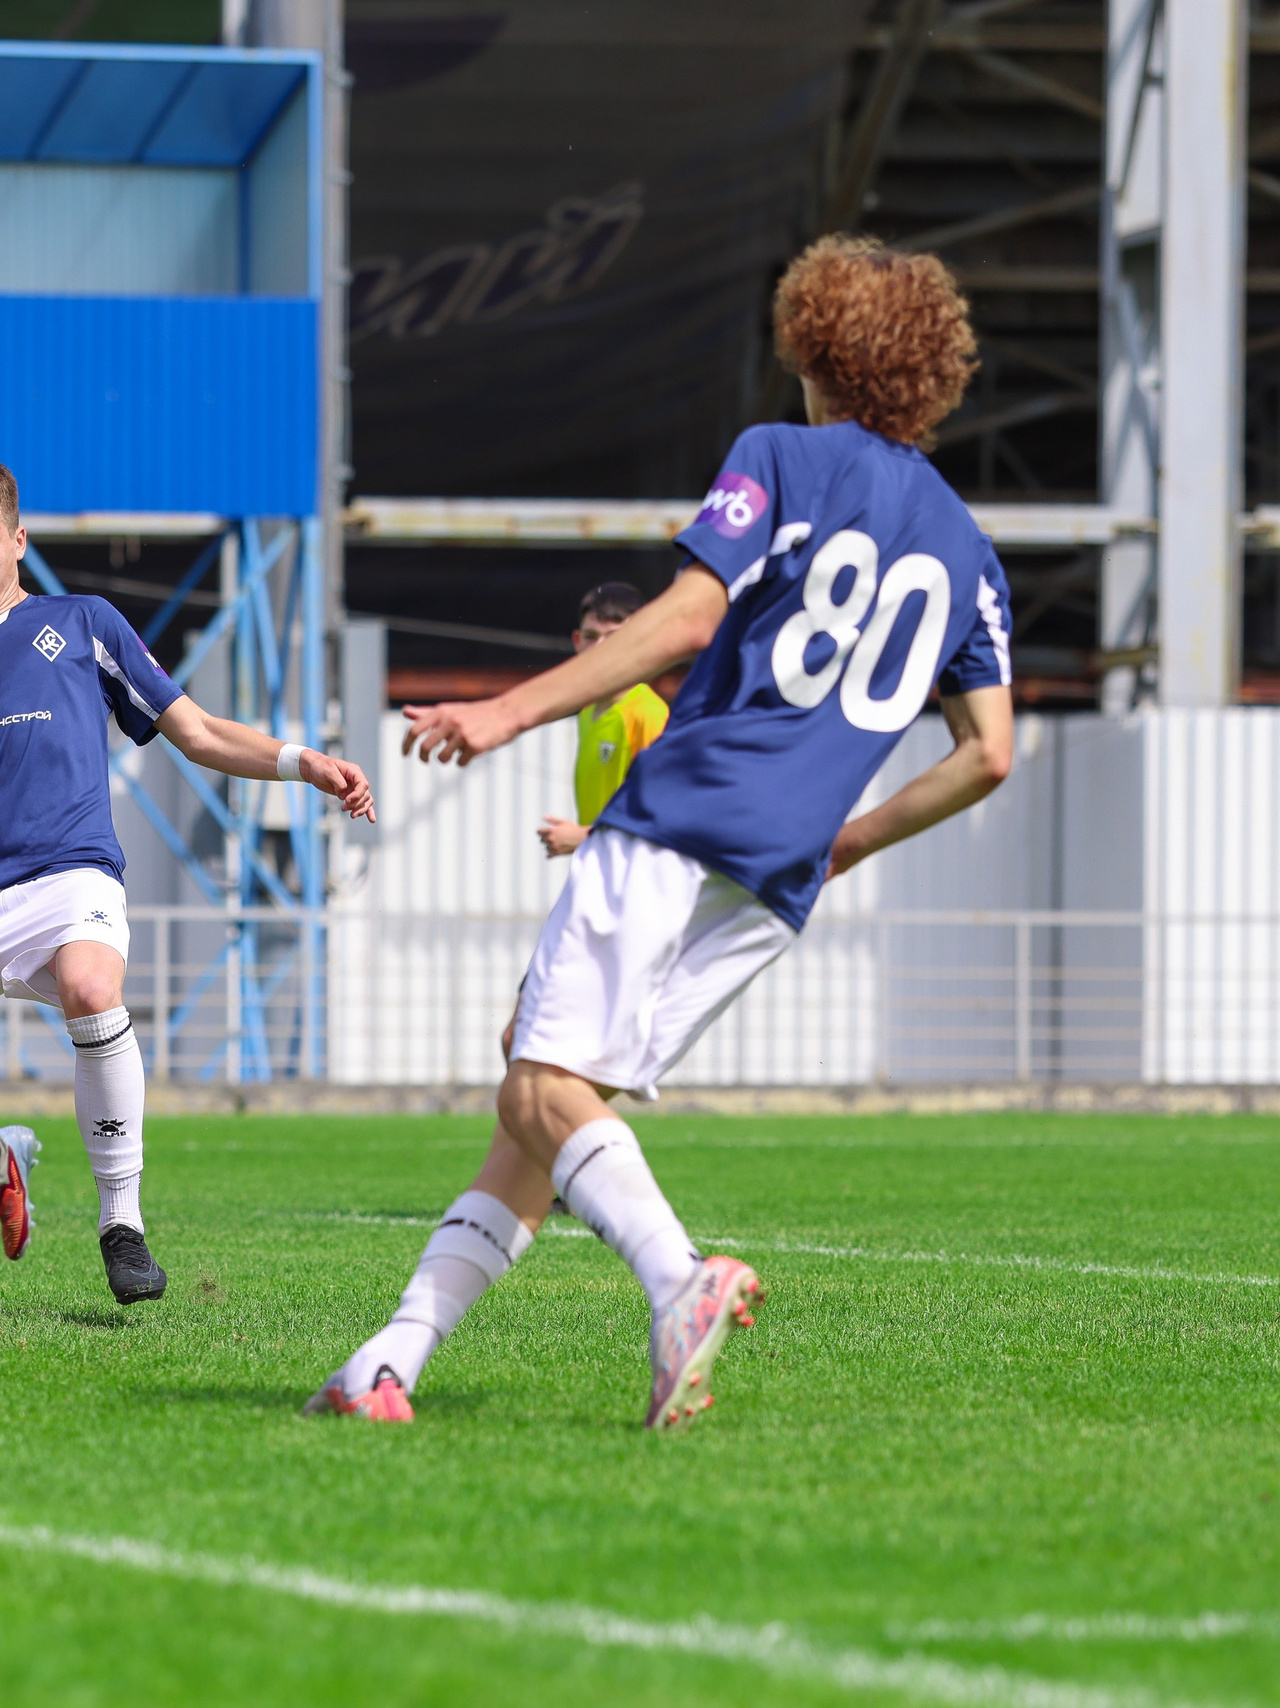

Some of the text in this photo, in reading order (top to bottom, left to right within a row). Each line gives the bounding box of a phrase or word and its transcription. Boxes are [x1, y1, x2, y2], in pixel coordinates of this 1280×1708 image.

[771, 529, 951, 733] 80
[84, 918, 113, 928] KELME
[92, 1130, 127, 1138] KELME
